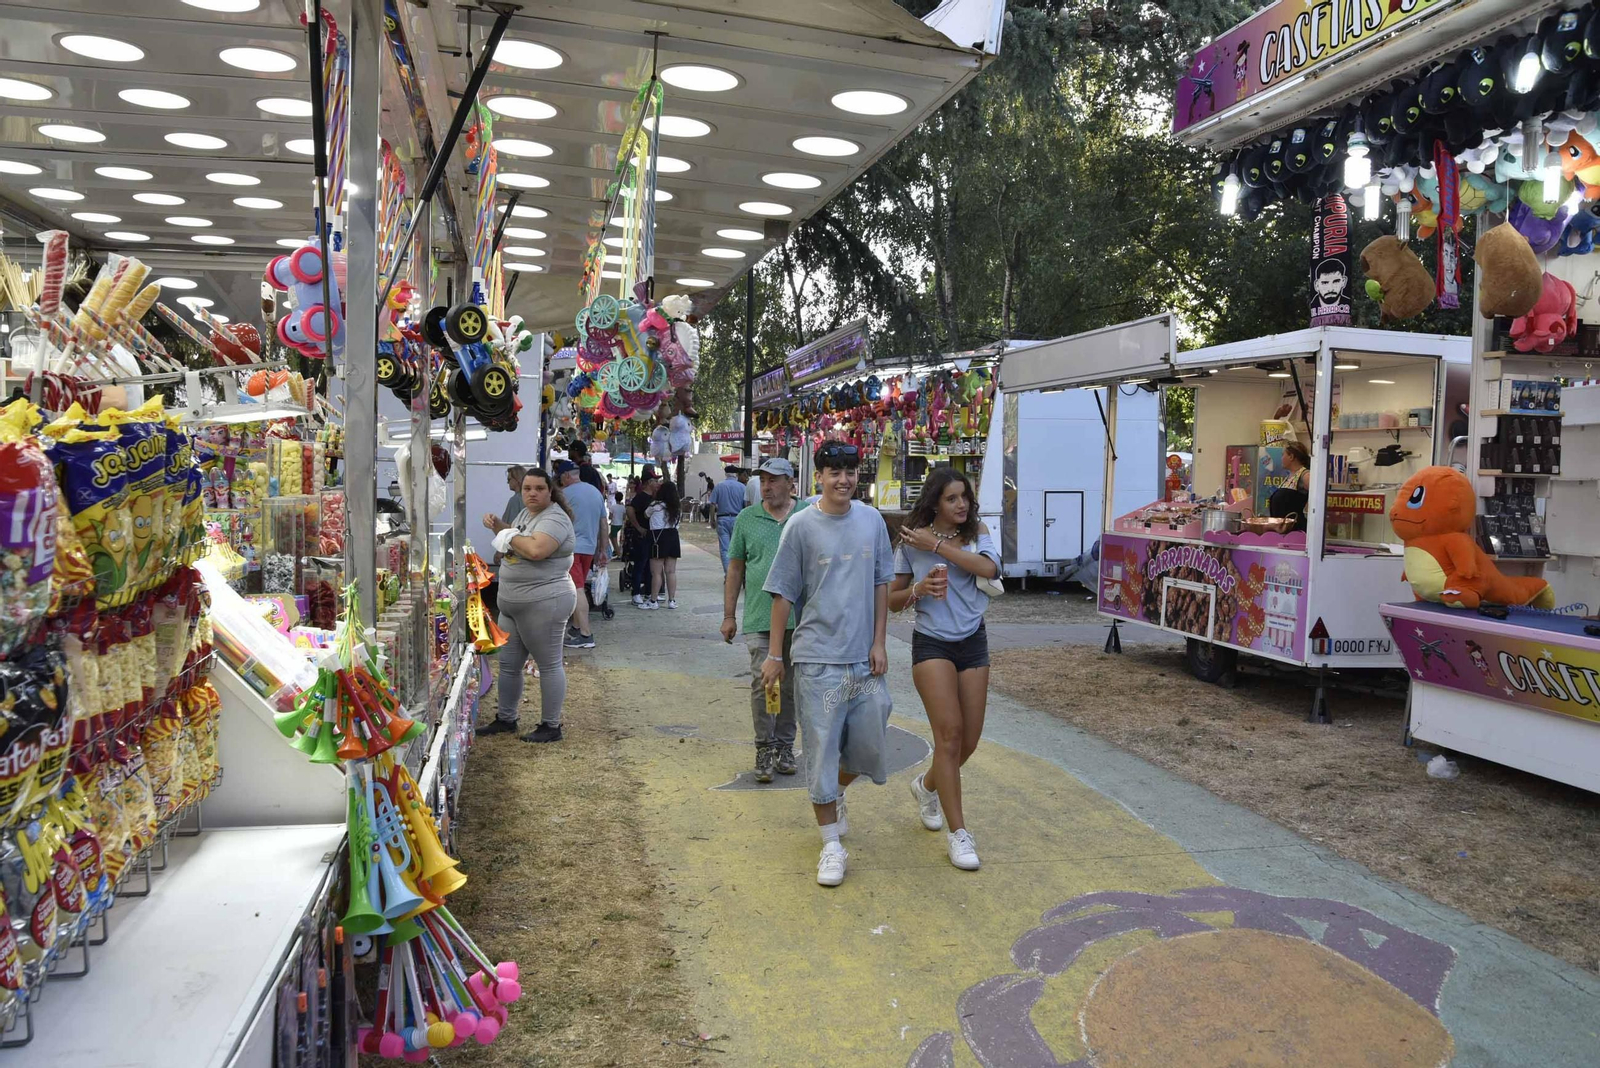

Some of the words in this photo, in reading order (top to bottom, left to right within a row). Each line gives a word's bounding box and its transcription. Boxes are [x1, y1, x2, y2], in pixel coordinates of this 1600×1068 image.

[1260, 0, 1382, 84] CASETAS
[1312, 216, 1321, 259] CHAMPION
[1318, 304, 1350, 316] MATADOR
[1327, 496, 1381, 510] PALOMITAS
[1148, 544, 1236, 594] GARRAPIÑADAS
[1334, 639, 1365, 653] 0000
[1368, 639, 1391, 653] FYJ
